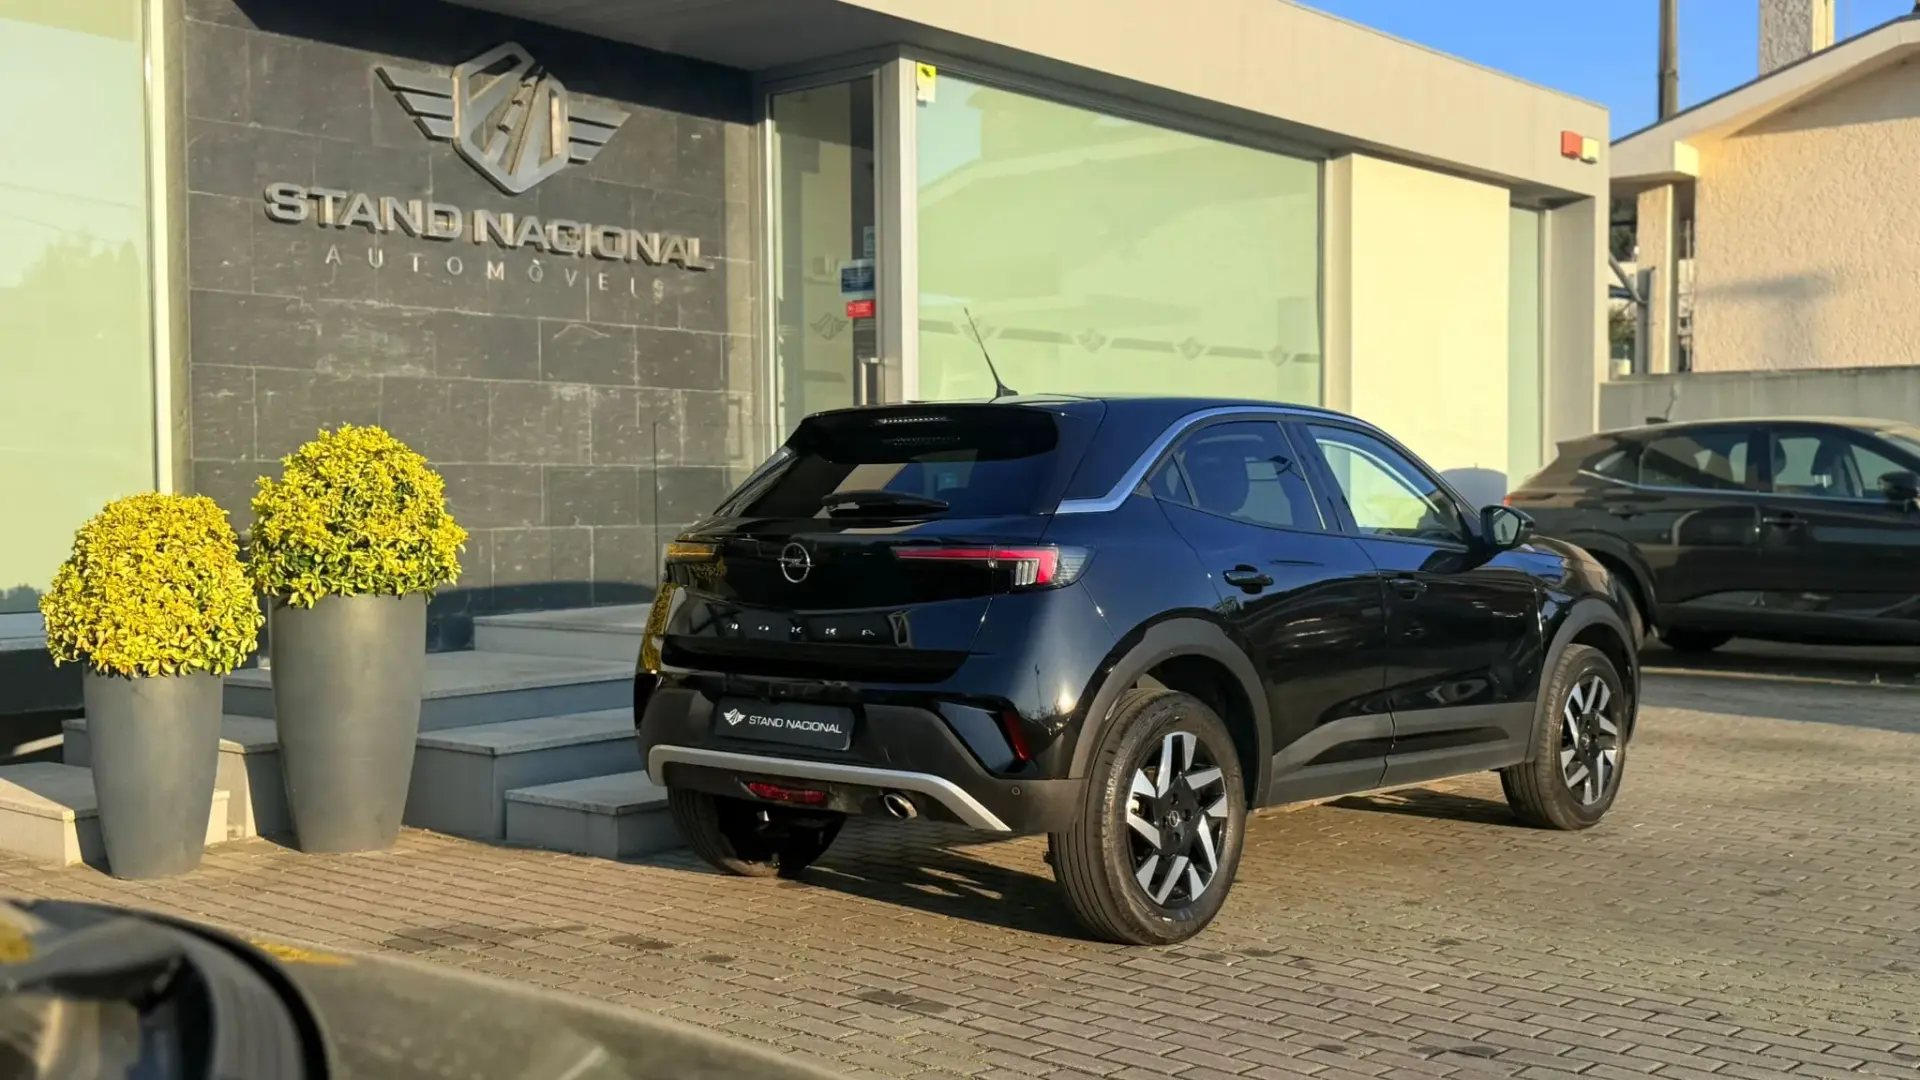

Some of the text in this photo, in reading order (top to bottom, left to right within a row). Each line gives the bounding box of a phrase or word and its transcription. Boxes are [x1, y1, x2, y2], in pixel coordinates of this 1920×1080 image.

[265, 182, 715, 270] STAND NACIONAL
[748, 715, 842, 733] STAND NACIONAL
